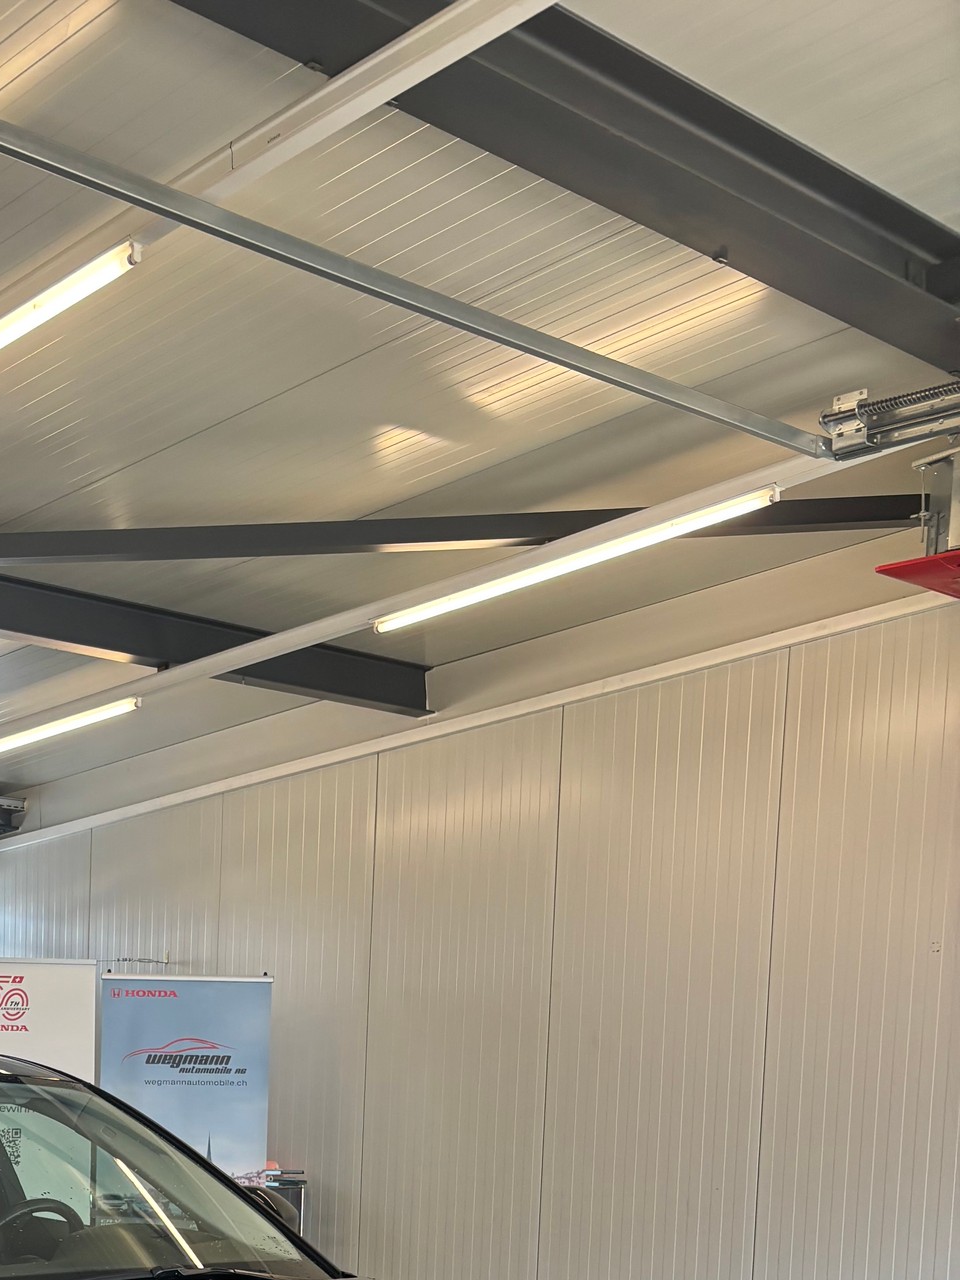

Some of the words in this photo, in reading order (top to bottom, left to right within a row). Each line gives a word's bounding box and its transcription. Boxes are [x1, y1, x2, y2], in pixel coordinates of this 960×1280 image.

[125, 989, 178, 998] HONDA
[145, 1053, 231, 1069] wegmann
[178, 1066, 232, 1075] automobile
[144, 1078, 248, 1087] wegmannautomobile.ch
